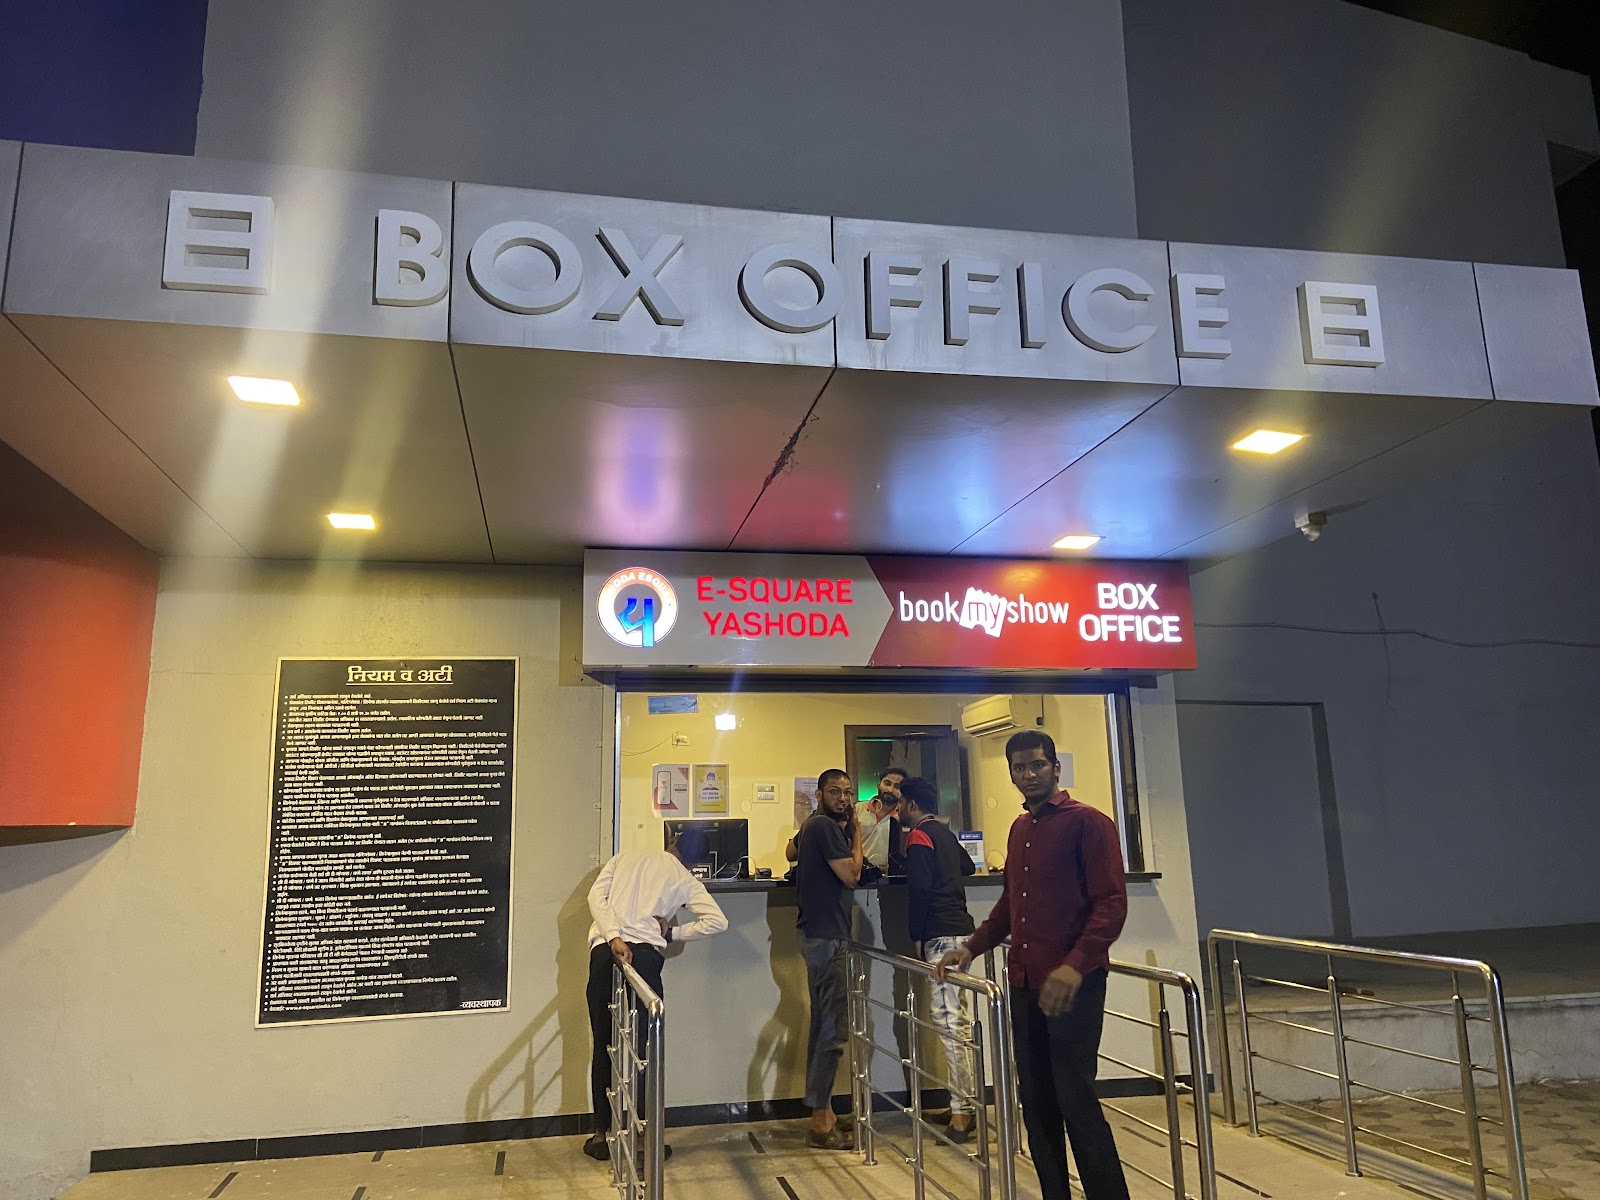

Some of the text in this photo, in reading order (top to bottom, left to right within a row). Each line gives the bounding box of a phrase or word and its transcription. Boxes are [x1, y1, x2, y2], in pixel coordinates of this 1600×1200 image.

[372, 209, 1233, 360] BOX OFFICE
[697, 576, 853, 604] E-SQUARE
[1097, 583, 1160, 611] BOX
[703, 611, 850, 638] YASHODA
[1079, 614, 1182, 643] OFFICE
[347, 665, 454, 682] नियम व अटी
